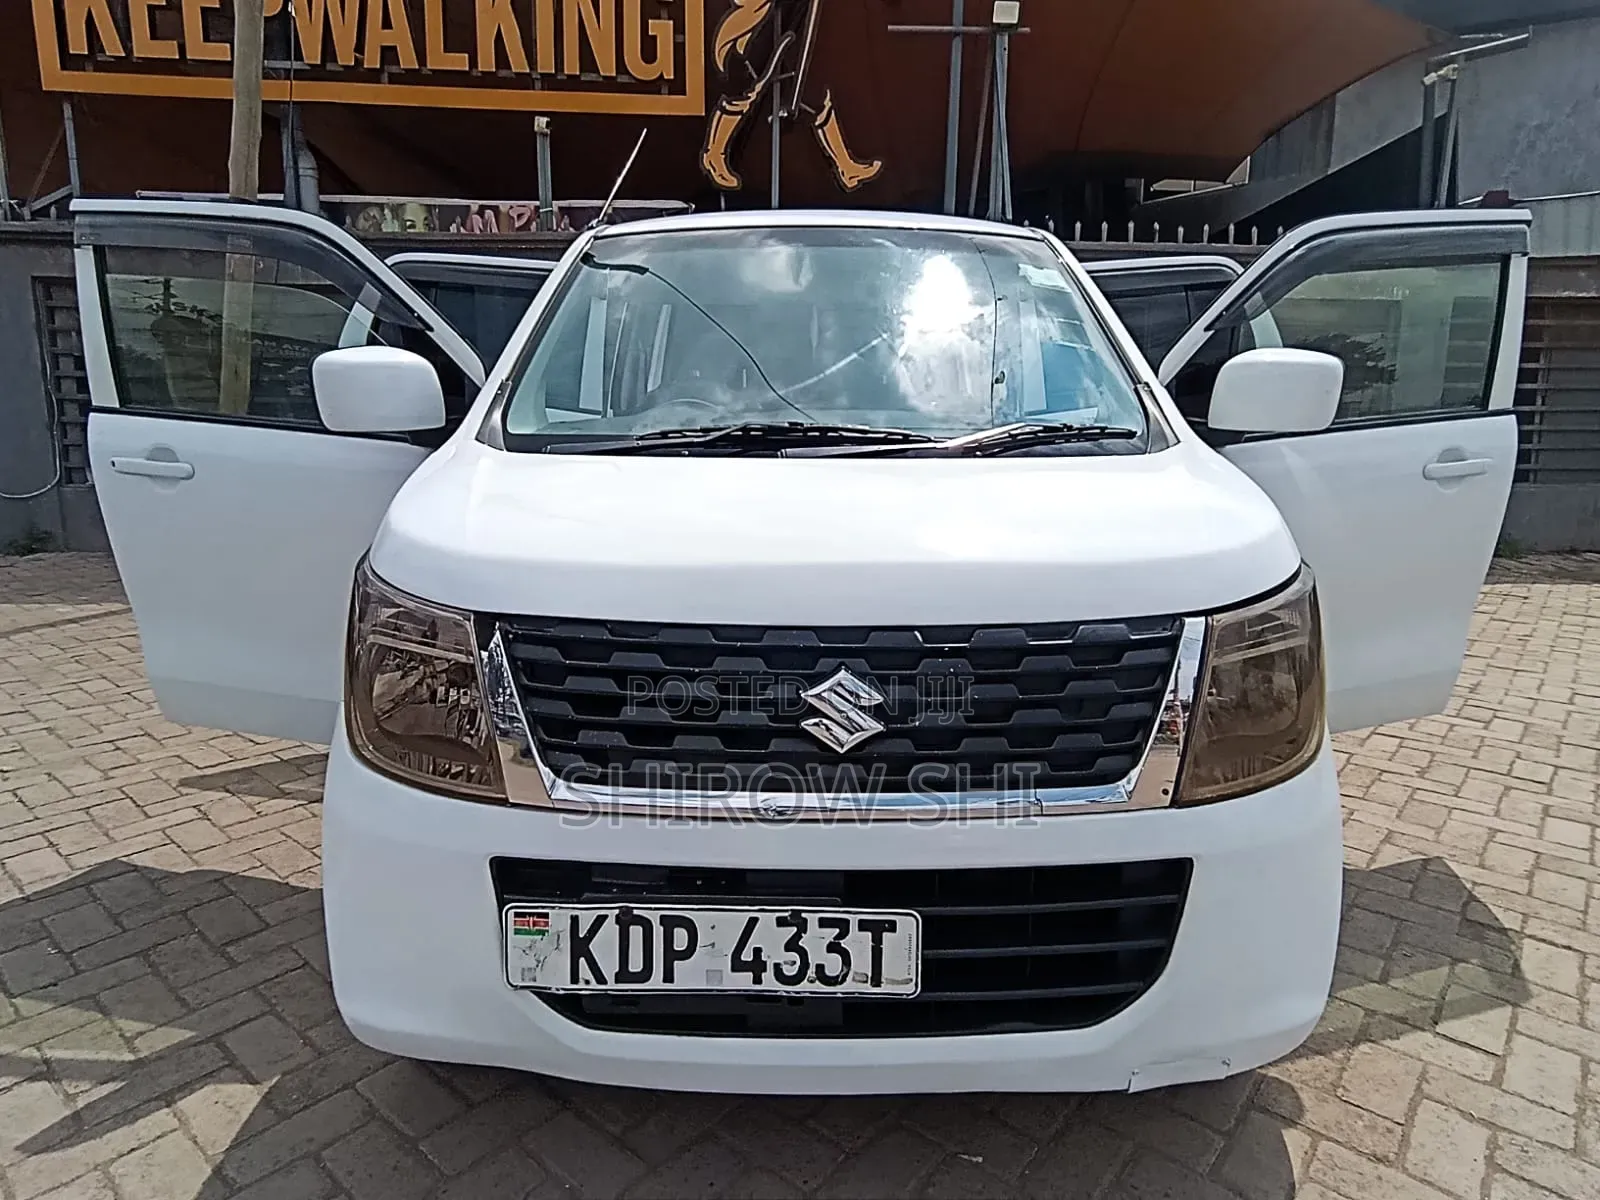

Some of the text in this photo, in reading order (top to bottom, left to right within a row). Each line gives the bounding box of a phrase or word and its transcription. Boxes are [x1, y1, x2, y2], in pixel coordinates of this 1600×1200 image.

[64, 0, 675, 81] KEE WALKING
[569, 913, 699, 986] KDP
[730, 916, 898, 988] 433T
